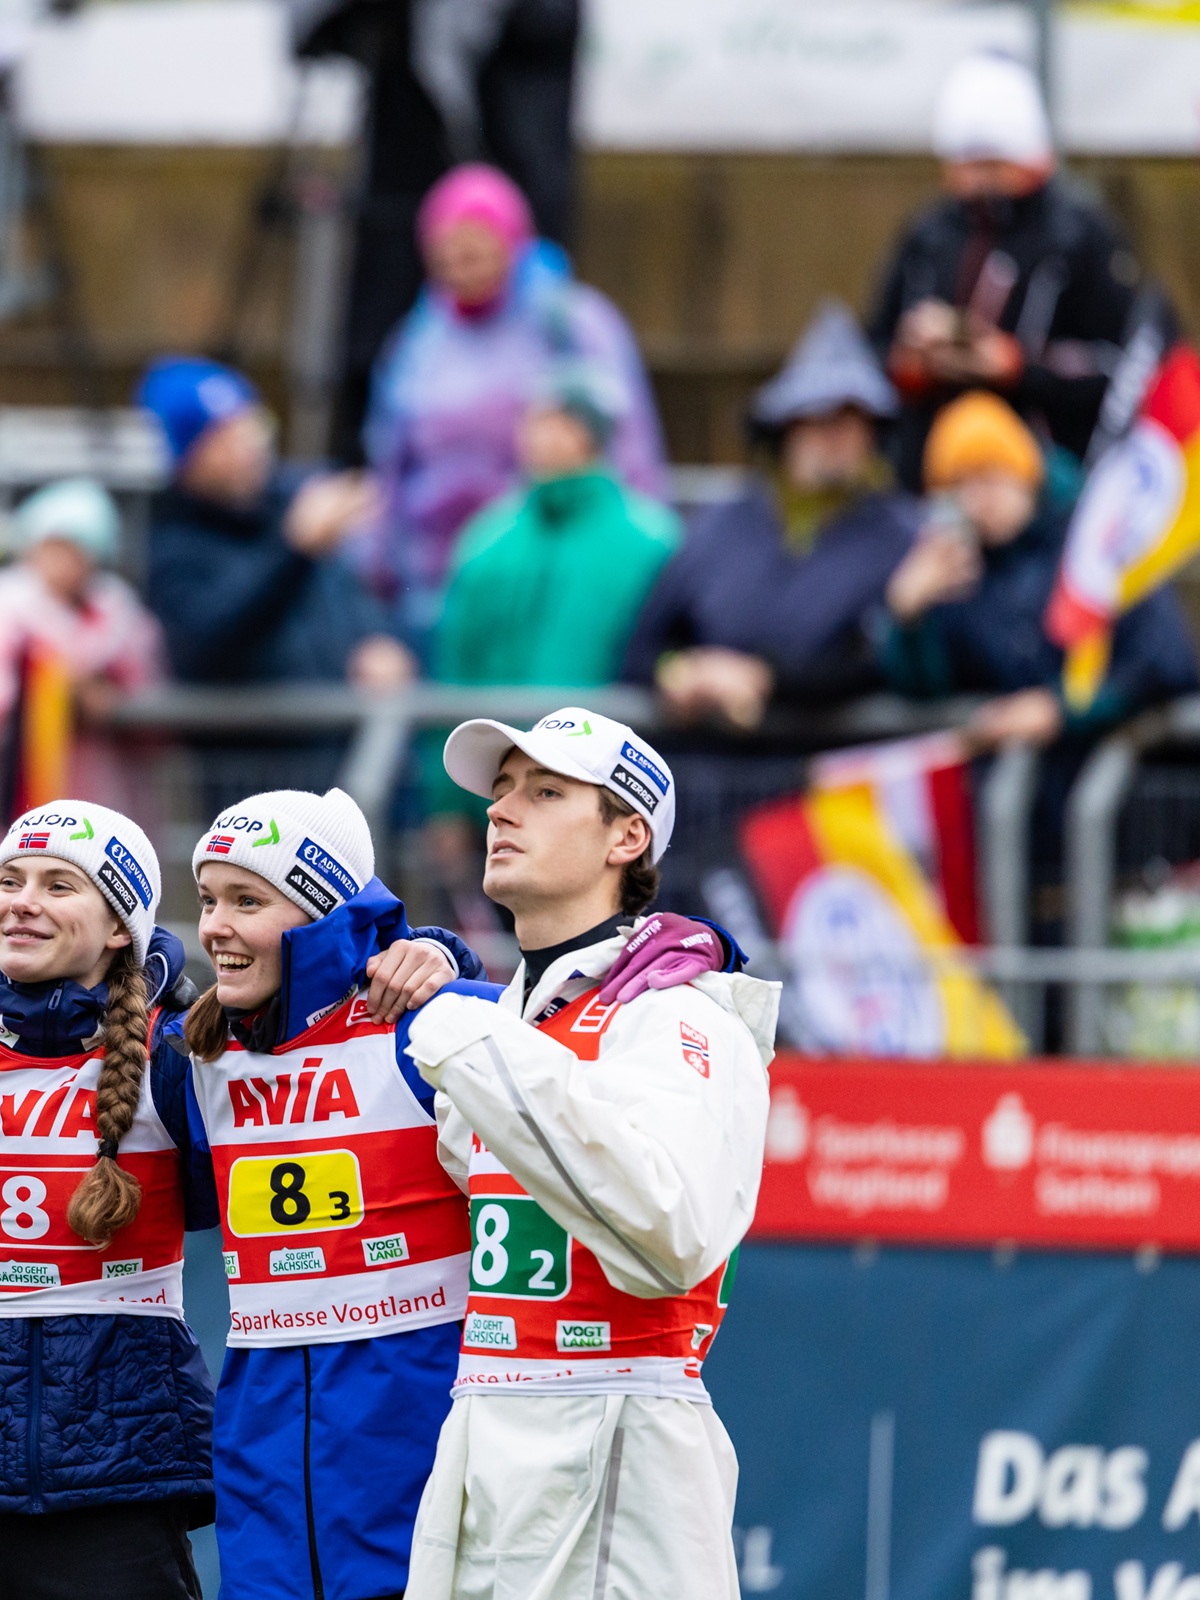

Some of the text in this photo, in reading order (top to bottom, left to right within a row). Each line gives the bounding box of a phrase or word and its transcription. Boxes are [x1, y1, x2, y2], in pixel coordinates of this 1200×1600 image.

[626, 776, 656, 808] TERREX
[124, 857, 152, 901] ADVANZIA
[320, 856, 355, 896] ADVANZIA
[111, 875, 135, 910] TERREX
[301, 878, 333, 910] TERREX
[269, 1162, 351, 1226] 8 3
[0, 1175, 50, 1240] 8
[285, 1251, 314, 1261] SO GEHT
[366, 1237, 401, 1252] VOGT
[369, 1246, 403, 1262] LAND
[471, 1203, 556, 1290] 8 2
[11, 1265, 48, 1275] SO GEHT
[106, 1262, 140, 1274] VOGT
[272, 1259, 323, 1273] SÄCHSISCH.
[231, 1286, 447, 1336] Sparkasse Vogtland
[465, 1327, 512, 1345] ÄCHSISCH.
[473, 1319, 503, 1331] SO GEHT
[562, 1325, 604, 1337] VOGT
[562, 1336, 604, 1348] LAND
[973, 1429, 1149, 1531] Das
